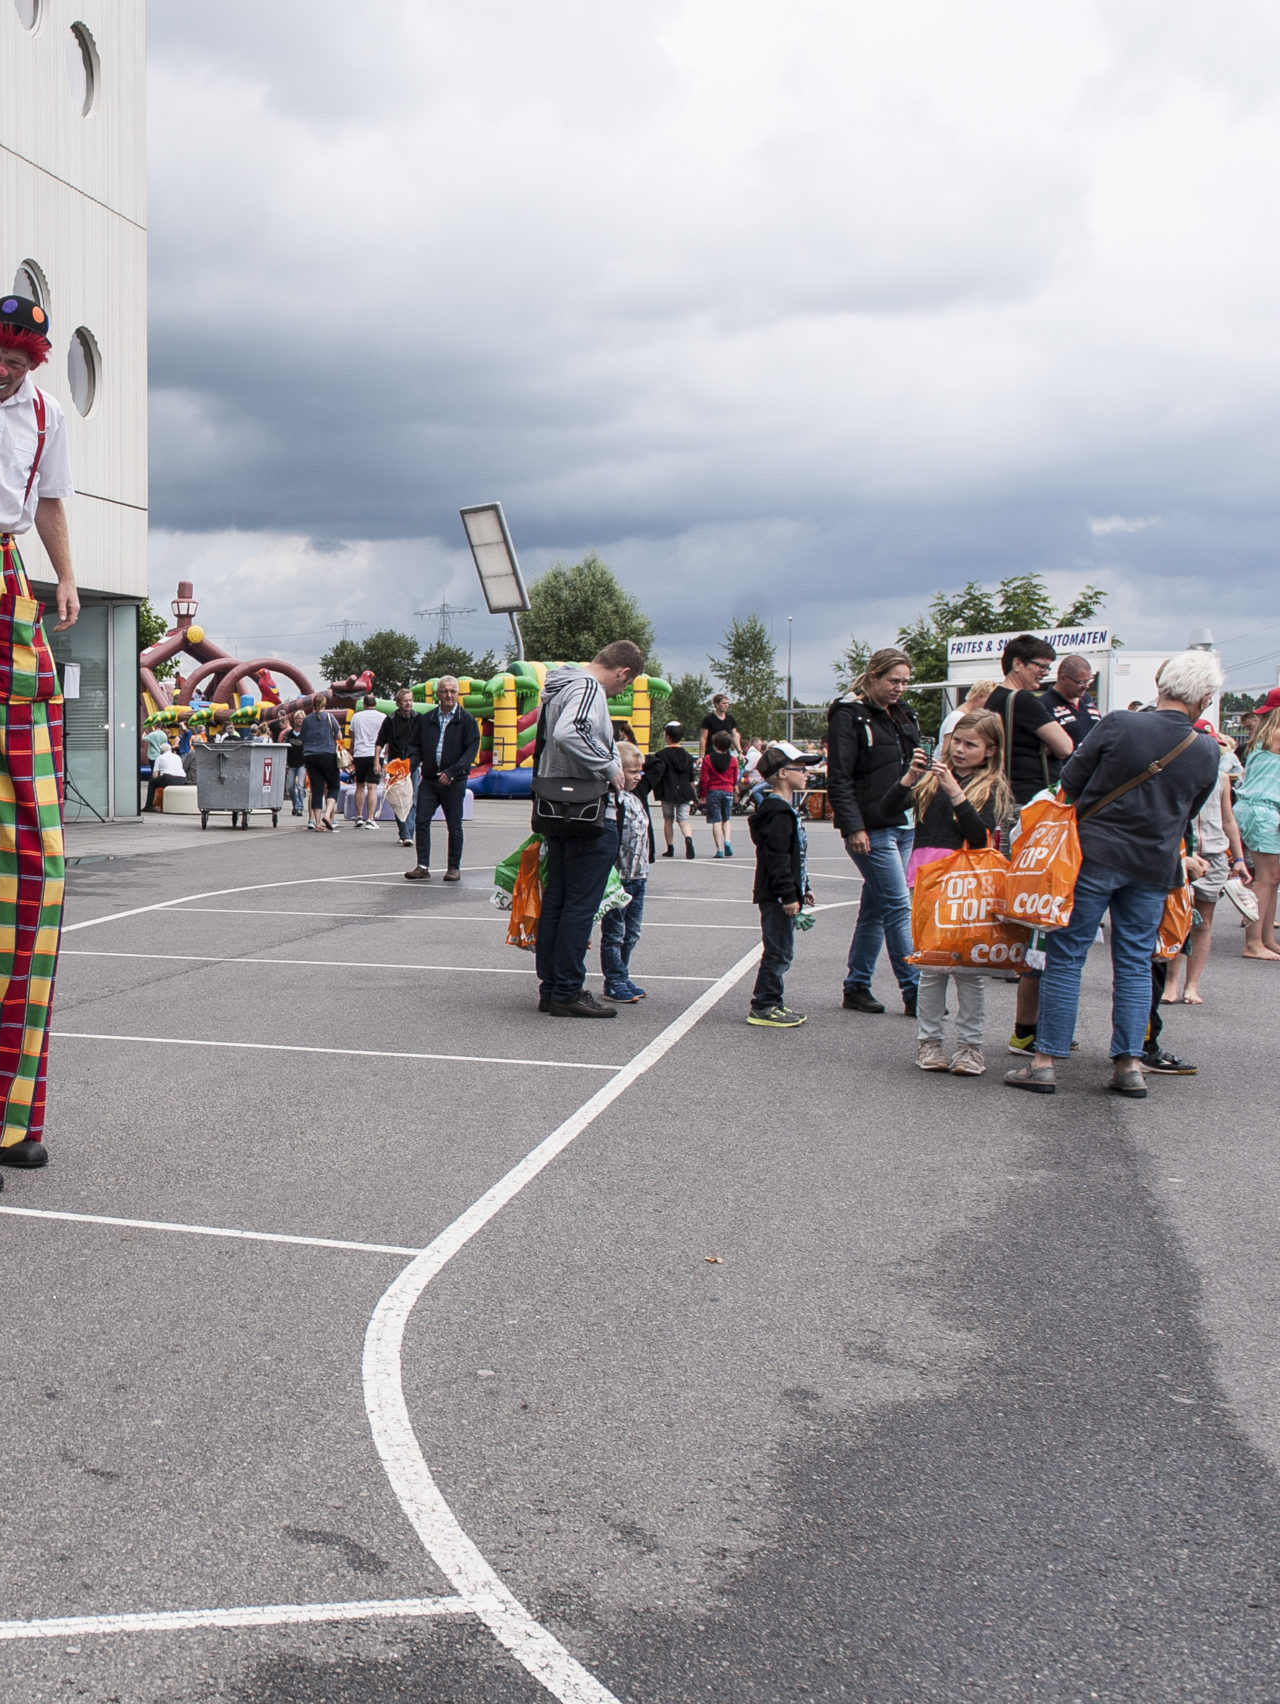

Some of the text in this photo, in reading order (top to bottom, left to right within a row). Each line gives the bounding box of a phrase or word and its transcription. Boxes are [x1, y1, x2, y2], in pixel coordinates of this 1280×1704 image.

[950, 641, 983, 655] FRITES
[985, 641, 993, 652] &
[947, 877, 978, 898] OP
